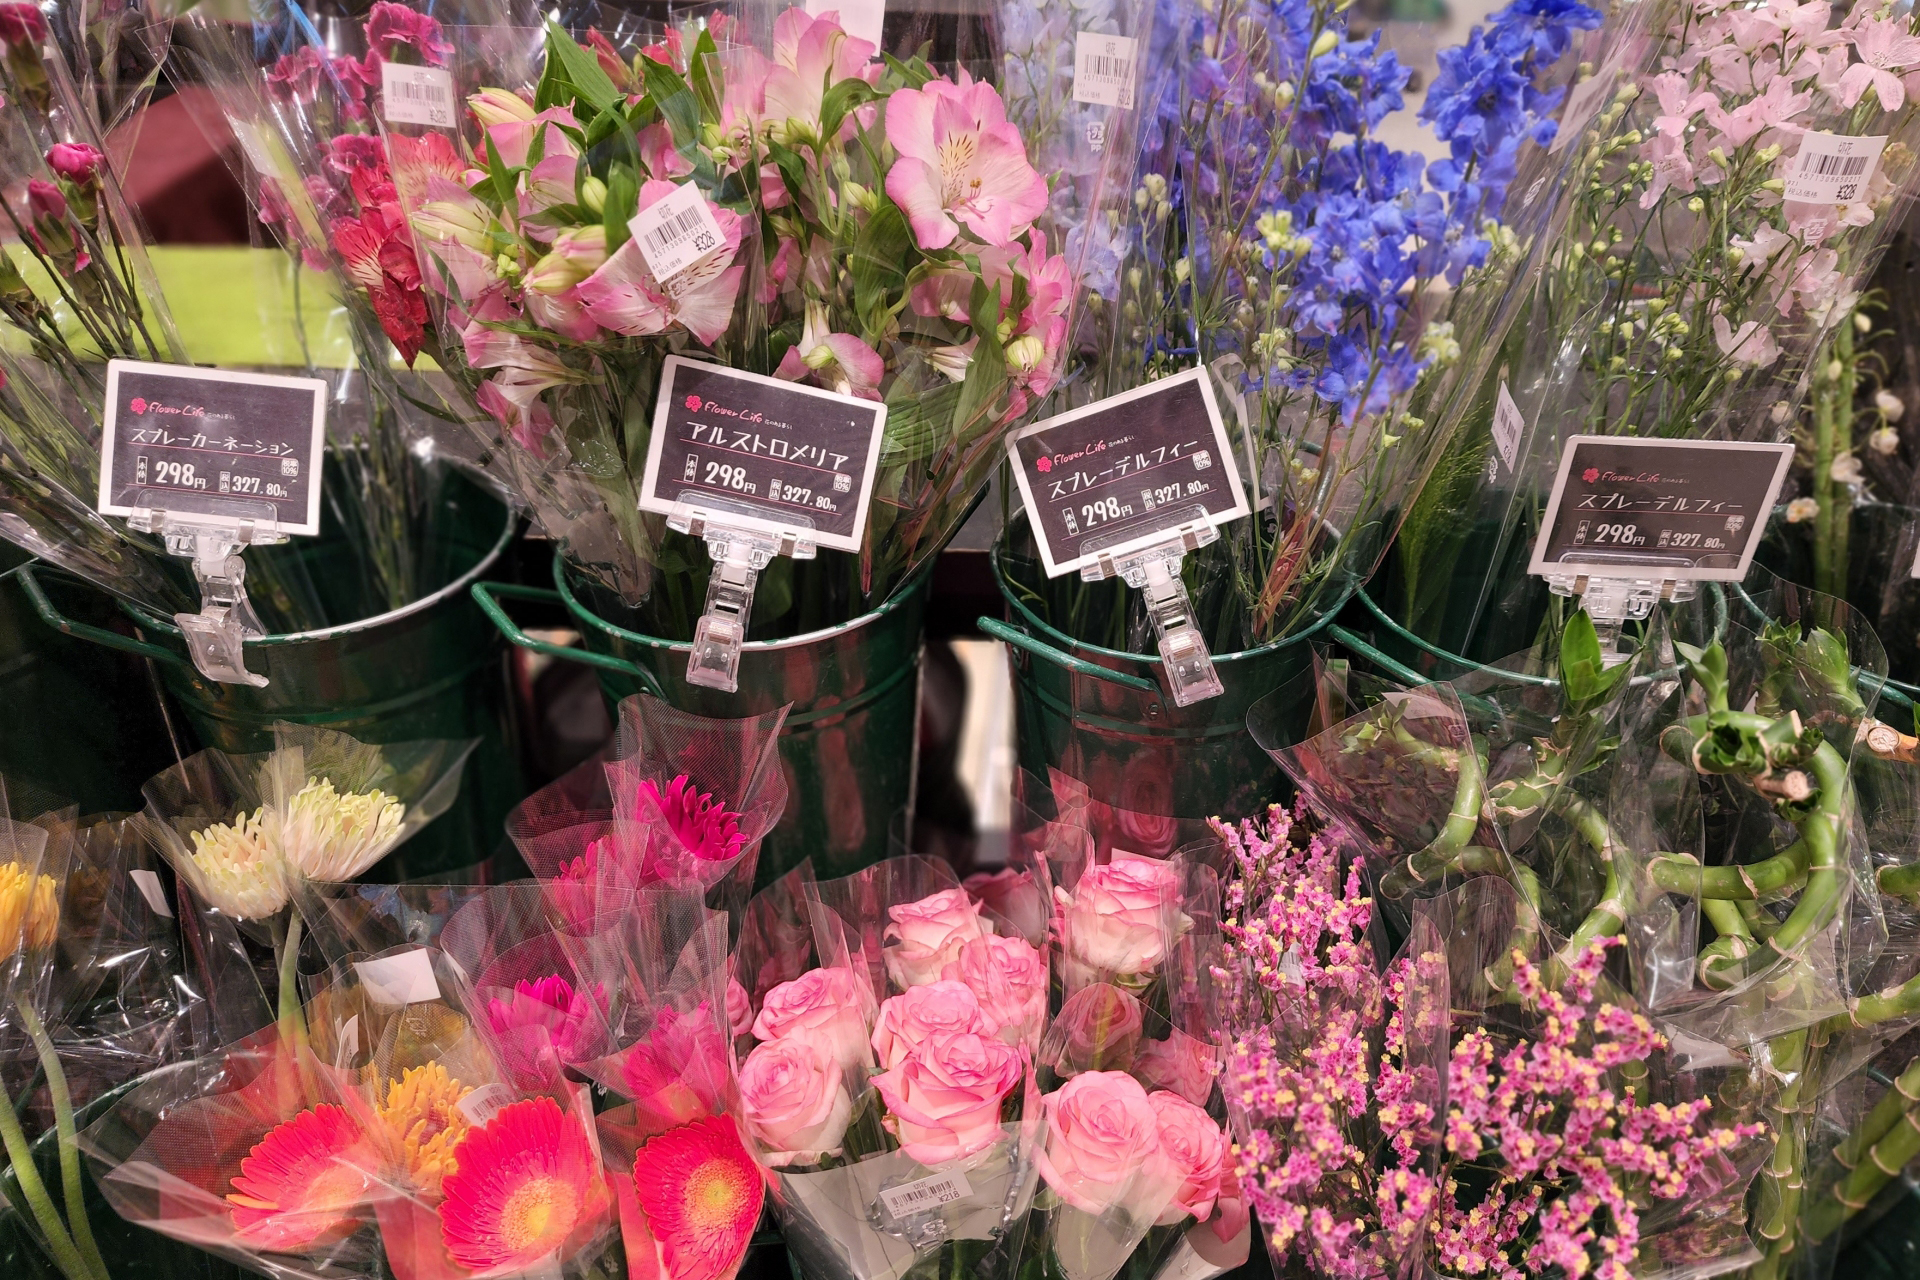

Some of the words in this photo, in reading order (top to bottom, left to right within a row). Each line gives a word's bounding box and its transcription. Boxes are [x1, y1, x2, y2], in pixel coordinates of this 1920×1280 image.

[1091, 144, 1102, 152] PP
[1836, 184, 1857, 201] ¥328
[692, 230, 716, 254] ¥328
[148, 401, 182, 415] Flower
[182, 403, 206, 418] Life
[703, 400, 739, 418] Flower
[739, 409, 763, 424] Life
[130, 428, 294, 456] スプレーカーネーション
[686, 421, 850, 470] アルストロメリア
[1053, 449, 1086, 467] Flower
[1085, 439, 1107, 455] Life
[1048, 439, 1199, 500] スプレーデルフィー
[1600, 470, 1636, 483] Flower
[1636, 472, 1660, 484] Life
[1577, 492, 1744, 513] スプレーデルフィー
[937, 1191, 961, 1204] ¥218
